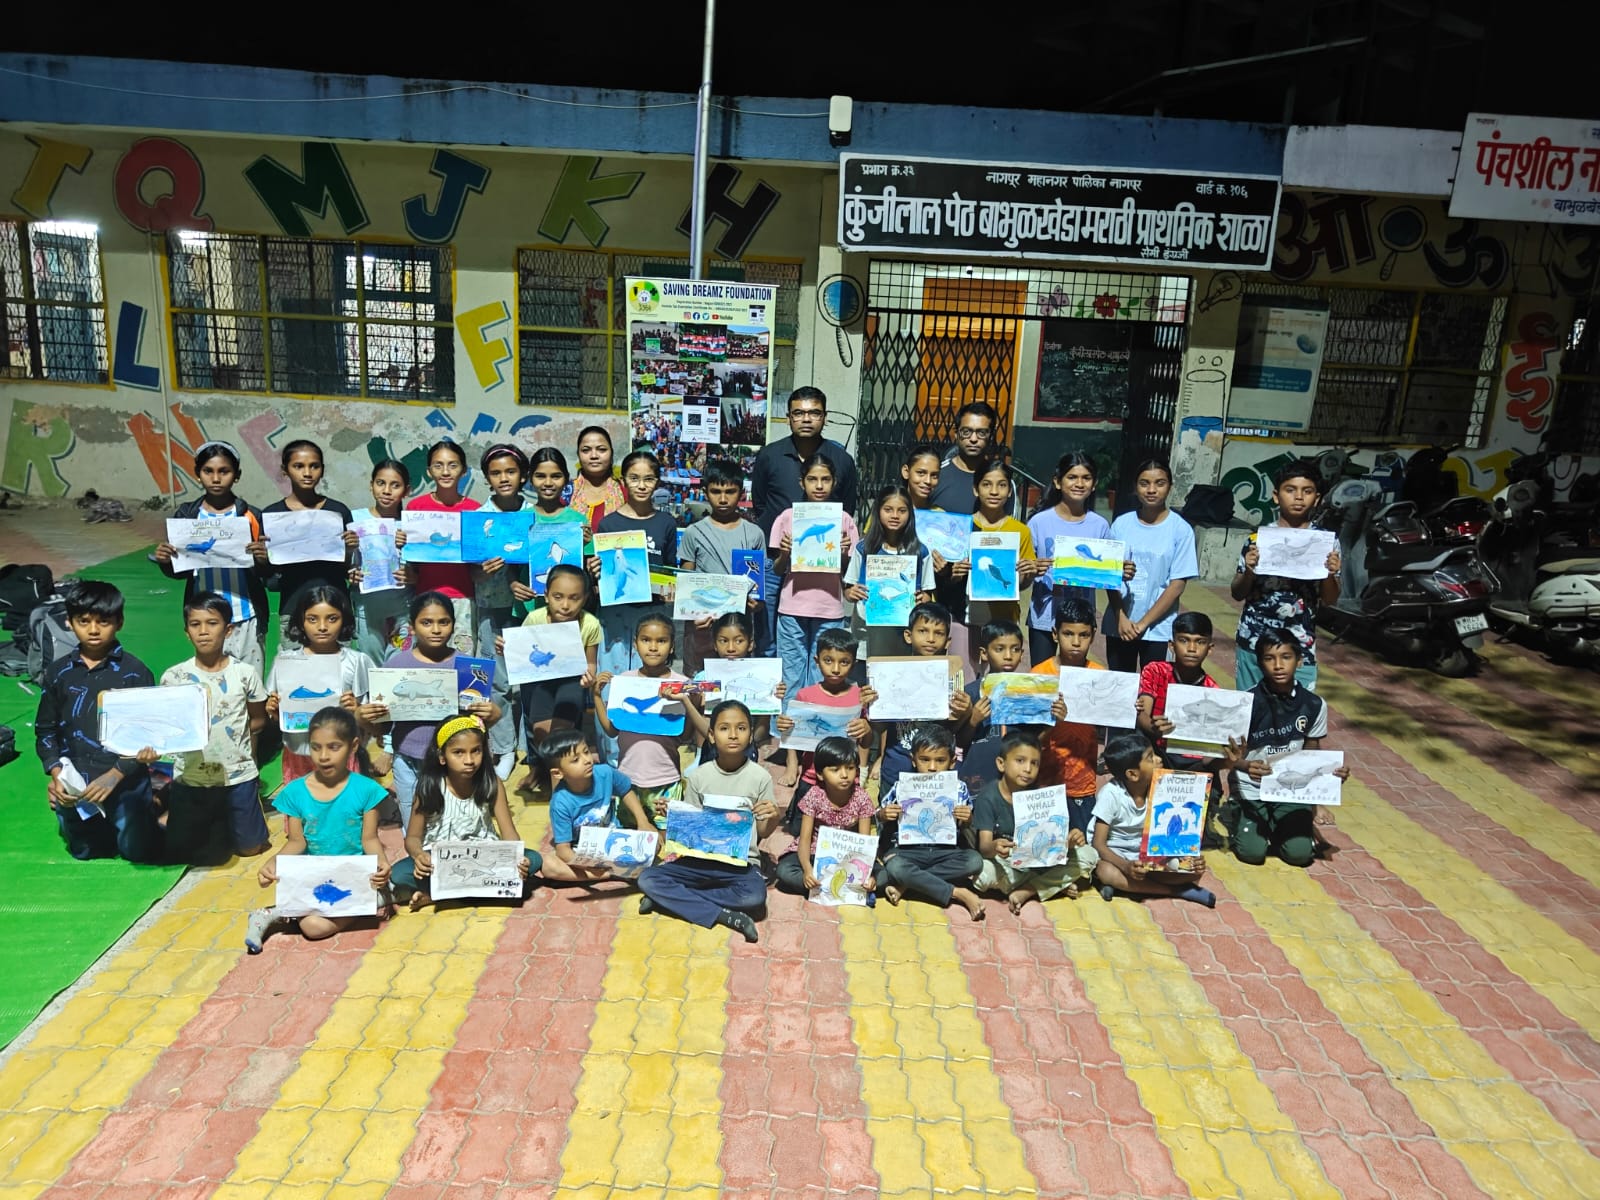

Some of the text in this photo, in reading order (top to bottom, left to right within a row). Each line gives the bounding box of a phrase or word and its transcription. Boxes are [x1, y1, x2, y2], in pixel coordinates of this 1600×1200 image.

[1476, 130, 1580, 192] पंचशील
[113, 136, 215, 236] Q
[1072, 174, 1106, 189] पालिका
[243, 142, 370, 237] M
[402, 148, 491, 245] J
[537, 154, 646, 248] K
[845, 185, 942, 242] कुंजीलाल
[943, 191, 978, 237] पेठ
[1081, 197, 1136, 246] मराठी
[1135, 202, 1216, 250] प्राथमिक
[1216, 212, 1272, 254] शाळा
[663, 282, 772, 301] SAVING DREAMZ FOUNDATION
[113, 300, 162, 392] L
[455, 300, 515, 393] F
[912, 773, 944, 782] WORLD
[1025, 790, 1055, 801] WORLD
[1166, 786, 1194, 794] WHALE
[1027, 799, 1056, 811] WHALE
[1172, 795, 1187, 803] DAY
[1035, 810, 1050, 820] DAY
[832, 831, 865, 845] WORLD
[439, 847, 479, 860] World
[831, 841, 864, 853] WHALE
